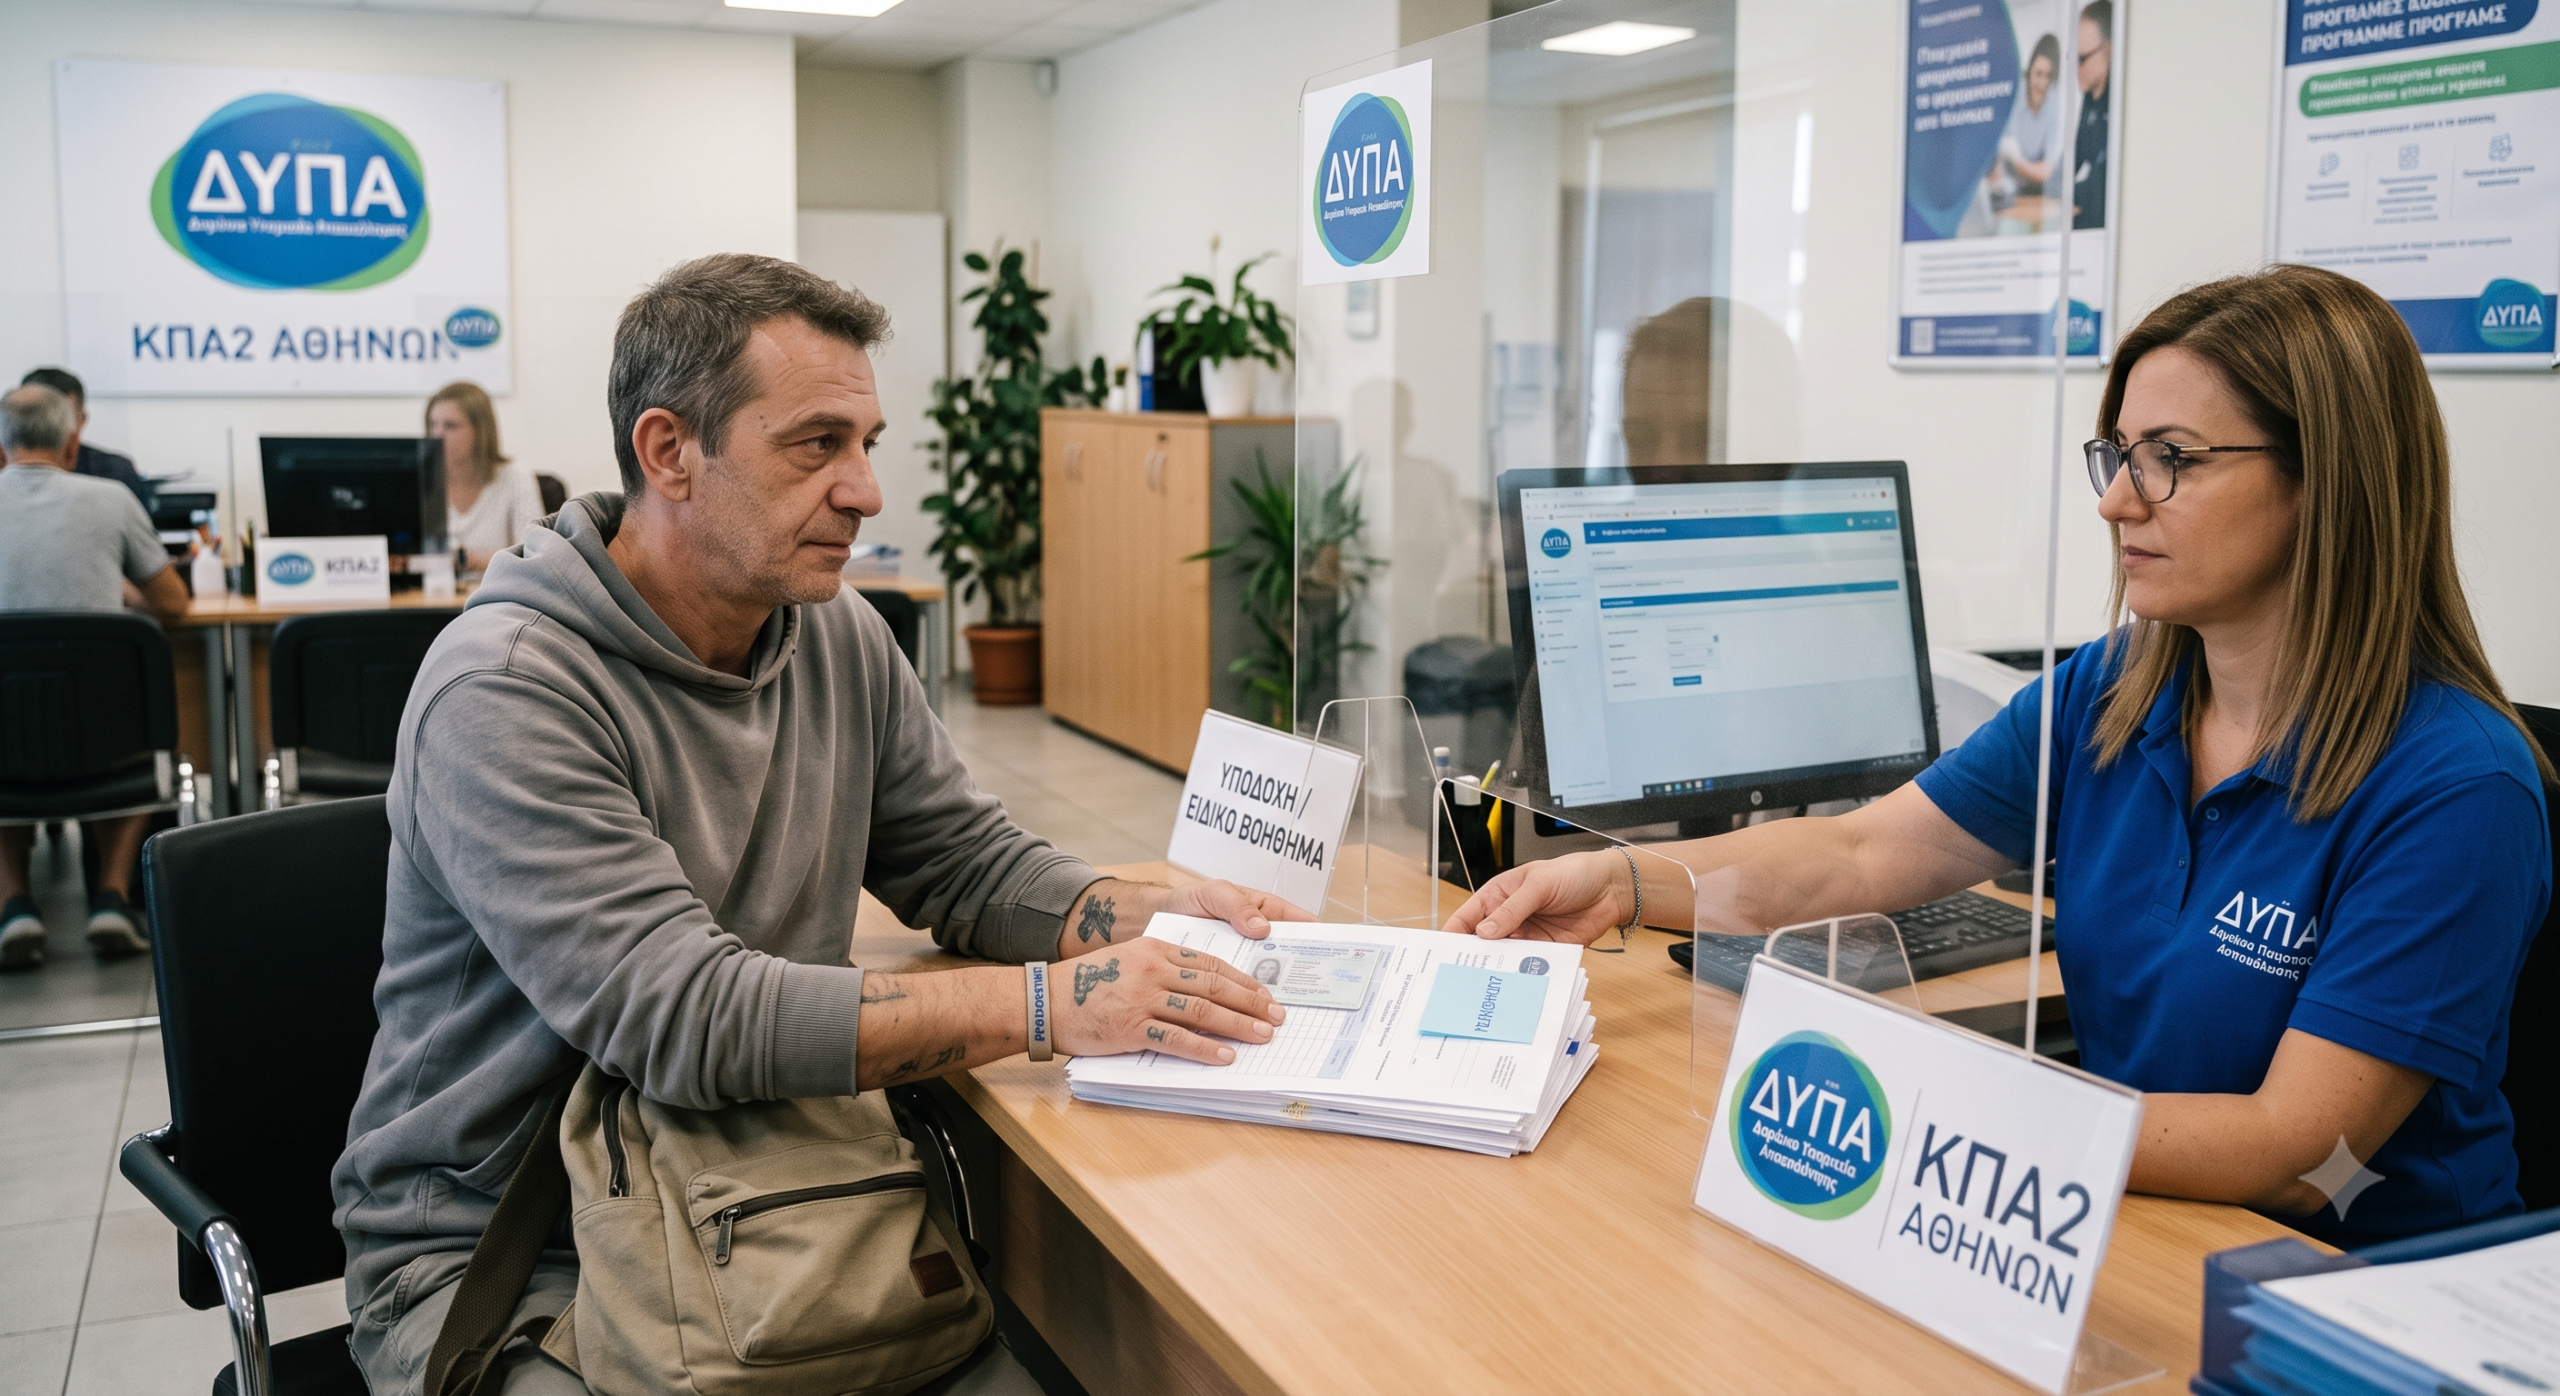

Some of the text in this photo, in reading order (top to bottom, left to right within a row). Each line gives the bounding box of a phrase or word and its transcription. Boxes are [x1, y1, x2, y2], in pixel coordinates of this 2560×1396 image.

[187, 149, 408, 218] ΔΥΠΑ
[1325, 139, 1405, 204] ΔΥΠΑ
[132, 324, 255, 361] ΚΠΑ2
[2481, 303, 2543, 327] ΔΥΠΑ
[1220, 762, 1314, 820] ΥΠΟΔΟΧΗ /
[1185, 794, 1325, 871] ΕΙΔΙΚΟ ΒΟΗΘΗΜΑ
[2214, 890, 2319, 949] ΔΥΠΑ
[1749, 1068, 1871, 1163] ΔΥΠΑ
[1913, 1123, 2091, 1259] ΚΠΑ2
[1898, 1202, 2074, 1315] ΑΘΗΝΩΝ
